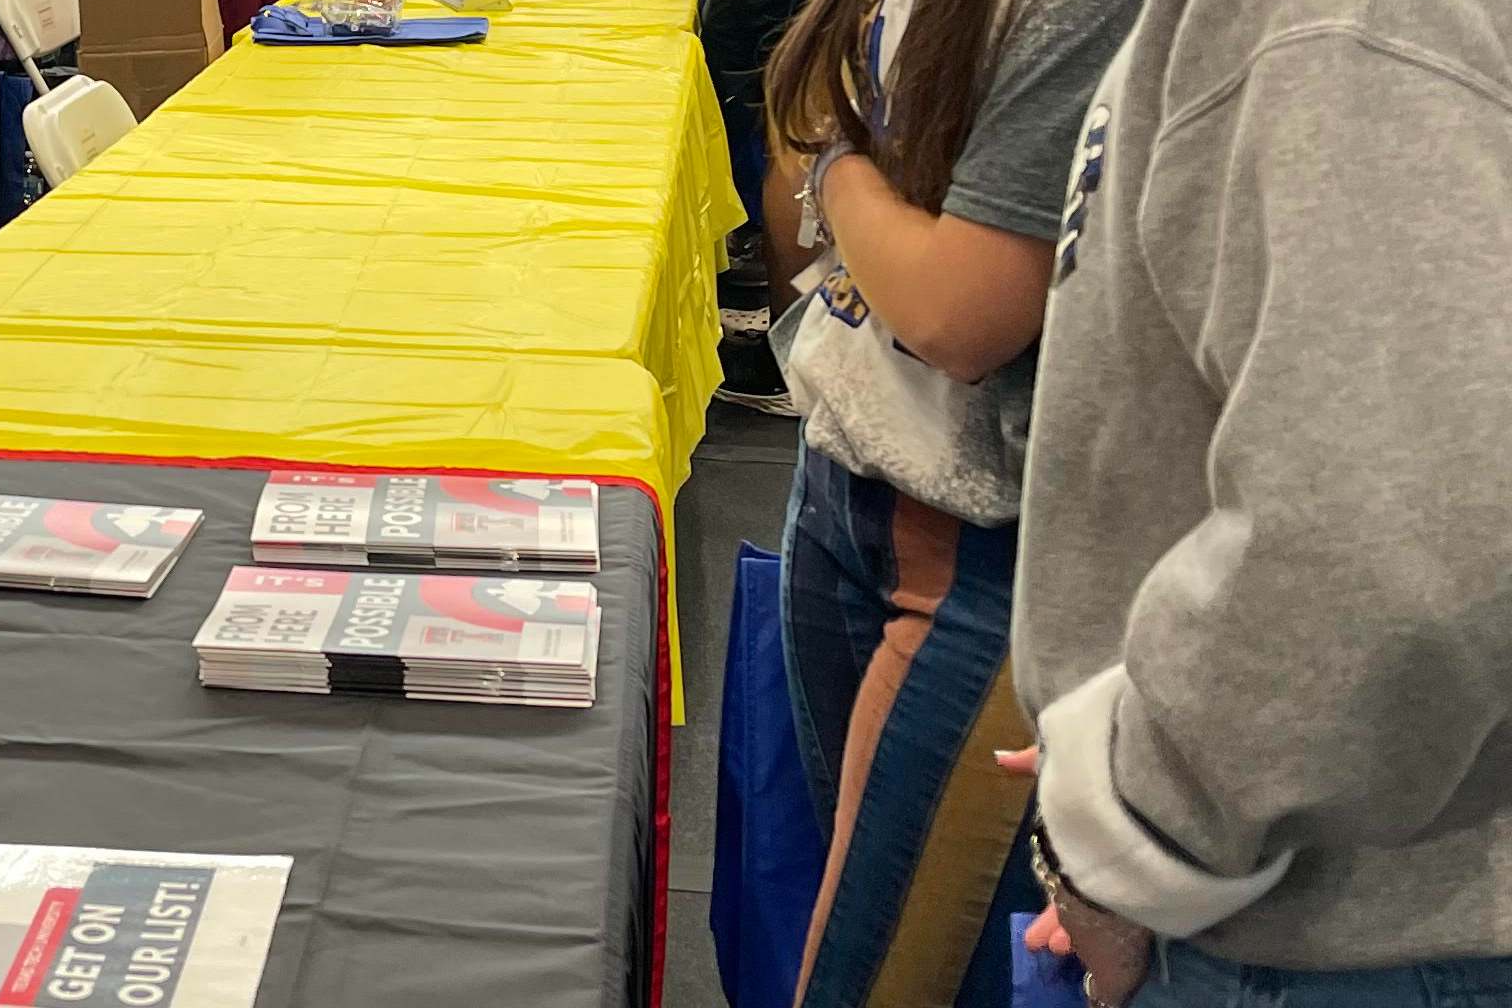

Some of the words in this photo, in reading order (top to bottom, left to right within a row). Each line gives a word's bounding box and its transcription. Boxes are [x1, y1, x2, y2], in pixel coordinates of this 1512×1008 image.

[269, 491, 313, 535] FROM
[314, 495, 356, 537] HERE
[380, 477, 428, 538] POSSIBLE
[254, 574, 325, 588] IT'S
[214, 603, 273, 643] FROM
[264, 608, 318, 645] HERE
[339, 577, 406, 649] POSSIBLE
[70, 903, 126, 945] ON
[139, 881, 201, 942] LIST!
[47, 945, 106, 1001] GET
[117, 945, 179, 1007] OUR
